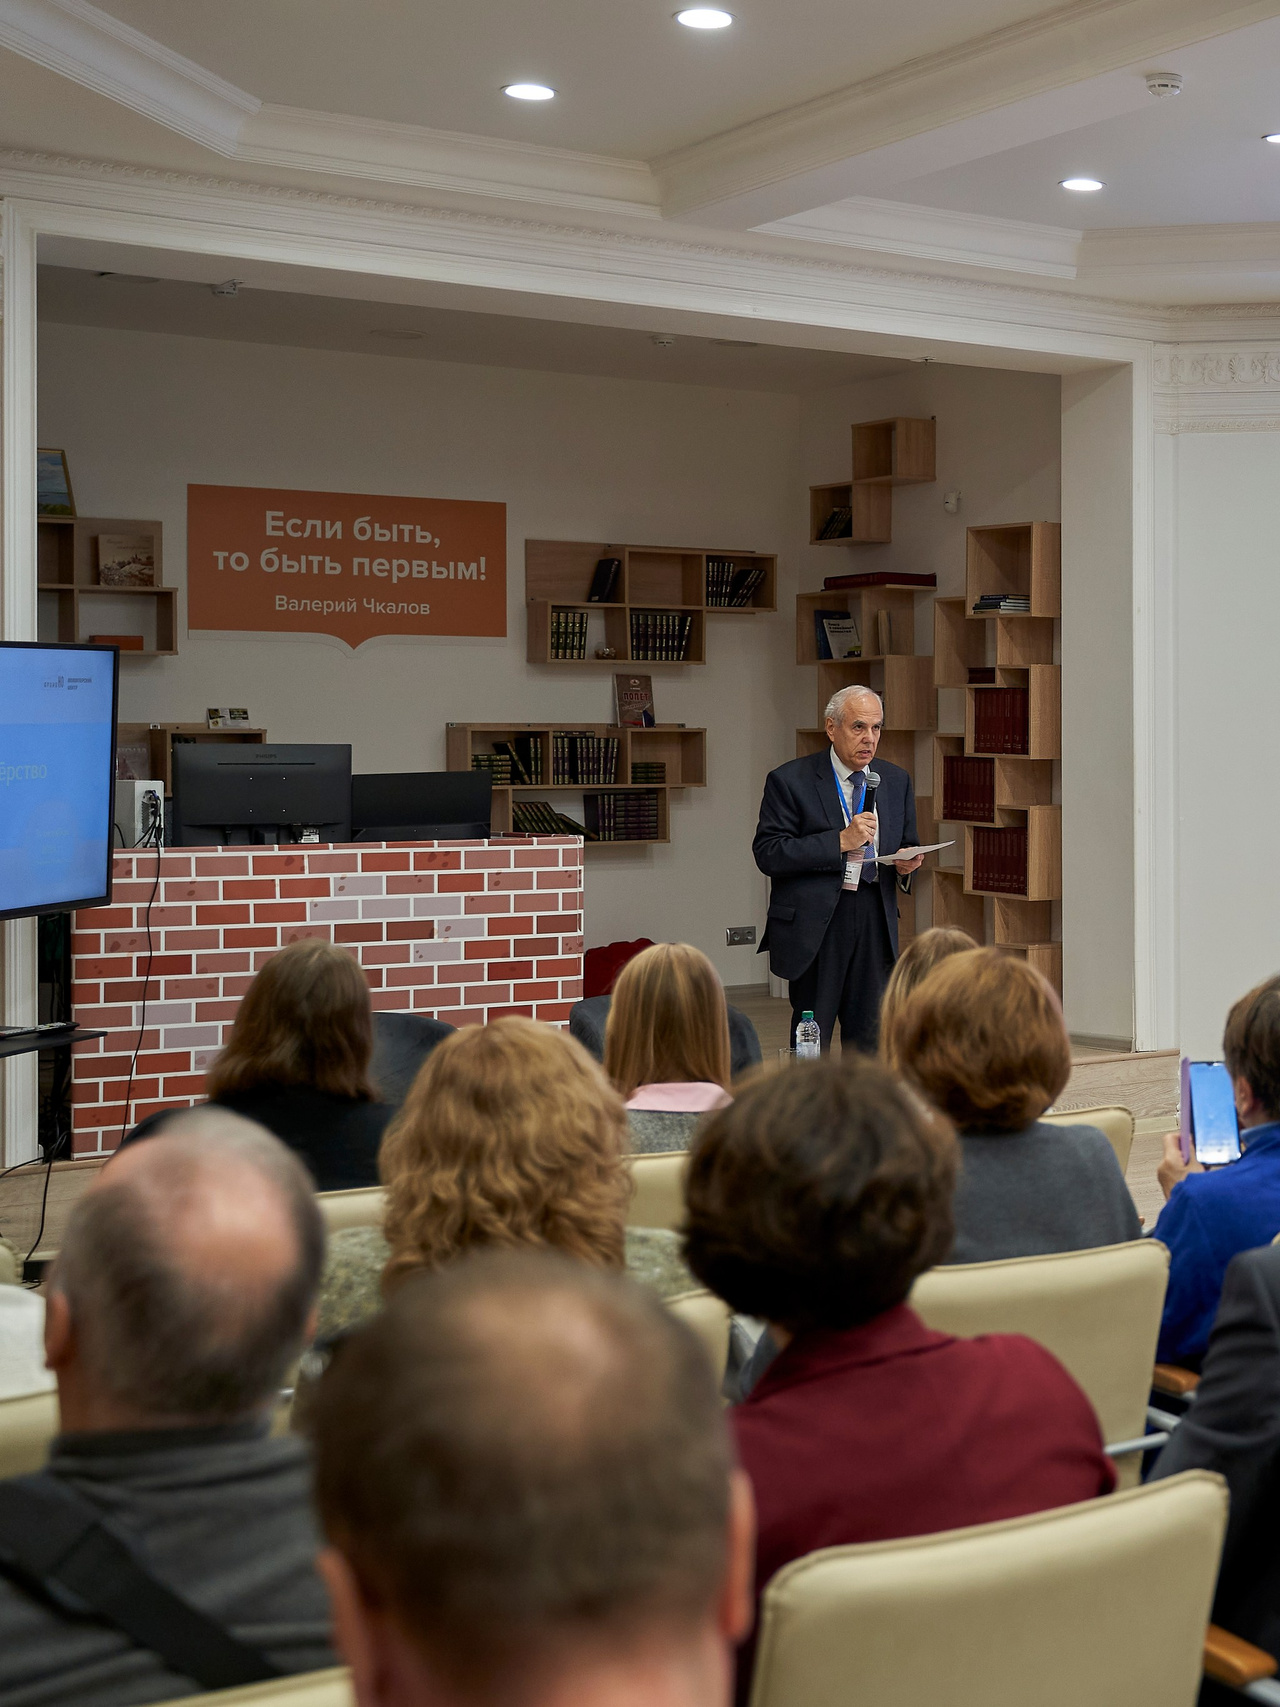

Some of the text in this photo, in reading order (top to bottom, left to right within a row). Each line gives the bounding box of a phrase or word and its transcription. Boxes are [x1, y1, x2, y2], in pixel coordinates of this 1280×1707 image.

[265, 510, 441, 549] Если быть,
[213, 547, 486, 584] то быть первым!
[275, 595, 431, 616] Валерий Чкалов
